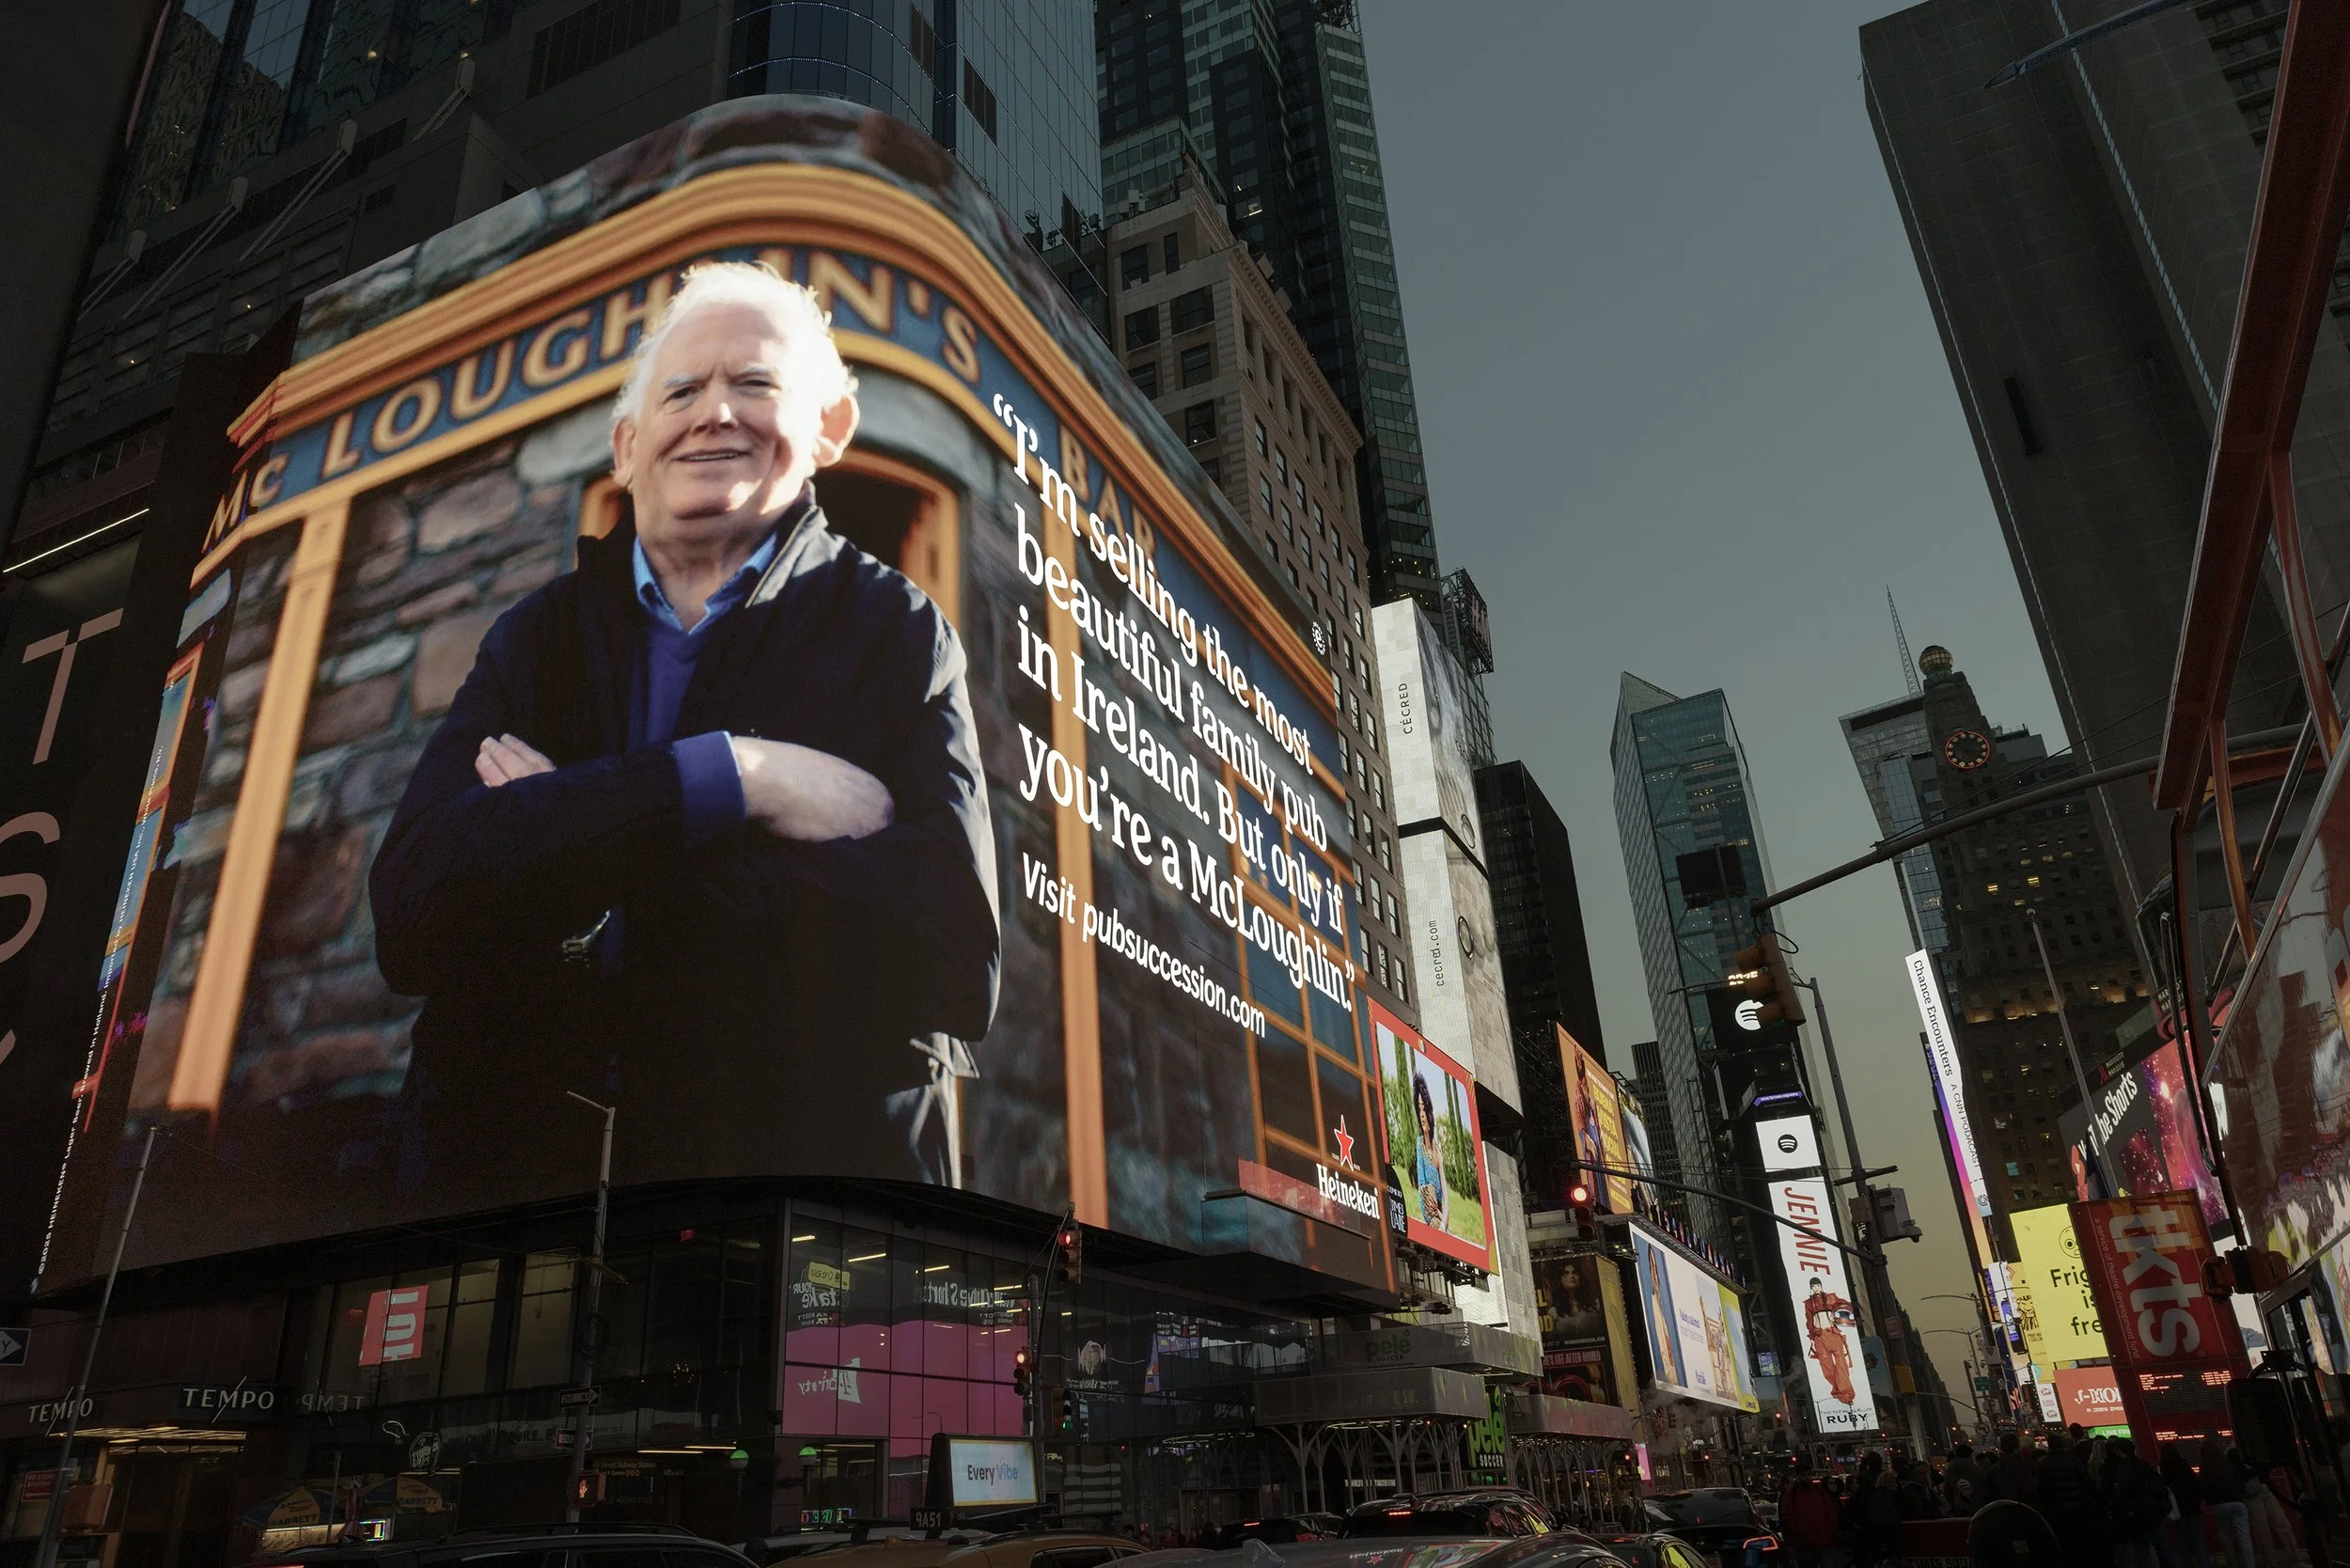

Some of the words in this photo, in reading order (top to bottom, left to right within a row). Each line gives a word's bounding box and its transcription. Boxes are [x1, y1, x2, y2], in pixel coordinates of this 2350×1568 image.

[321, 245, 981, 478] LOUGHN'S
[1014, 502, 1184, 723] beautiful
[1190, 680, 1277, 815] family
[1281, 778, 1326, 853] pub
[1089, 511, 1198, 668] selling
[1203, 622, 1250, 709] the
[1254, 682, 1314, 776] most
[1402, 682, 1413, 735] CÉCRED
[1018, 604, 1062, 702] in
[1071, 651, 1211, 825] Ireland.
[1214, 778, 1267, 871] But
[1271, 843, 1323, 928] only
[1327, 873, 1345, 936] if
[1018, 723, 1153, 867] you’re
[1161, 834, 1184, 891] a
[1022, 851, 1076, 926] Visit
[1083, 900, 1266, 1039] pubsuccession.com
[1428, 918, 1445, 987] cecred.com
[64, 1126, 75, 1159] Lager
[79, 1050, 94, 1092] Brewed
[103, 945, 118, 989] Imported
[118, 870, 135, 923] HEINEKEN
[132, 847, 141, 868] USA
[1913, 959, 1932, 1004] Chance
[1926, 1005, 1953, 1076] Encounters
[1953, 1092, 1965, 1114] CNN
[2104, 1071, 2138, 1127] Shorts
[1316, 1162, 1380, 1220] Heineken
[1784, 1186, 1831, 1276] JENNIE
[2096, 1225, 2108, 1252] service
[2107, 1262, 2120, 1291] theatre
[2114, 1290, 2133, 1342] development
[2130, 1341, 2142, 1359] fund
[2108, 1204, 2203, 1357] tkts
[564, 1393, 575, 1403] ONE
[581, 1390, 595, 1401] WAY
[1826, 1413, 1867, 1423] RUBY
[967, 1465, 995, 1485] Every
[995, 1464, 1019, 1481] Vibe
[1480, 1454, 1504, 1467] SOCCER
